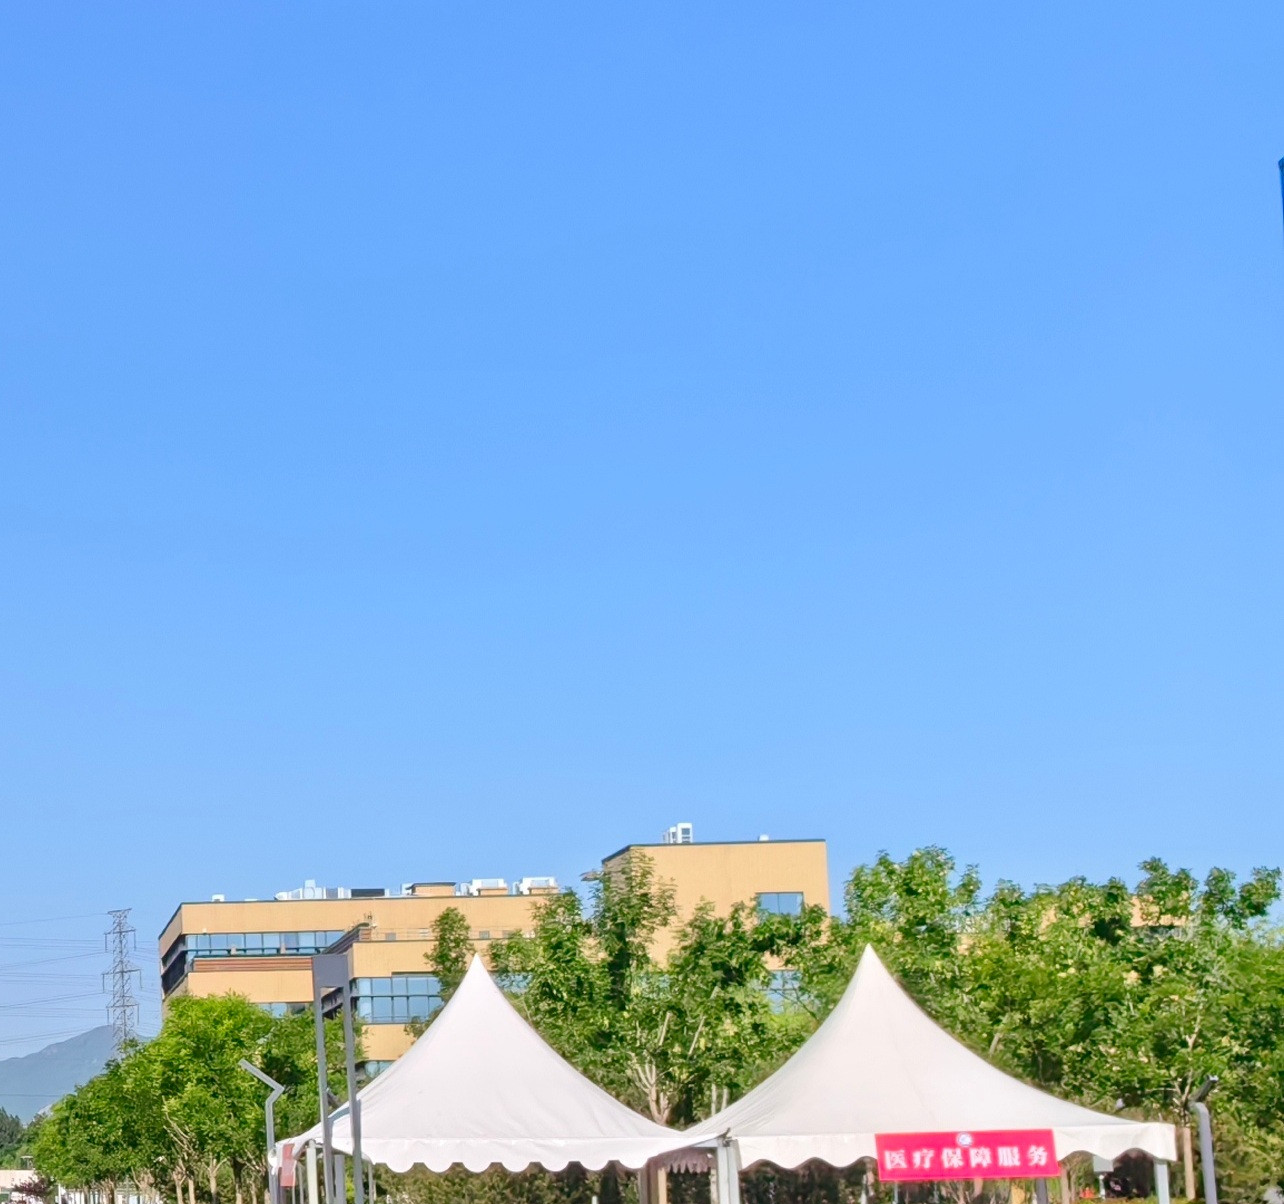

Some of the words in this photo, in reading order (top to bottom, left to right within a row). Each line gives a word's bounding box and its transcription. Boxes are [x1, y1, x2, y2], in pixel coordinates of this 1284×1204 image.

[884, 1145, 1049, 1171] 医疗保障服务
